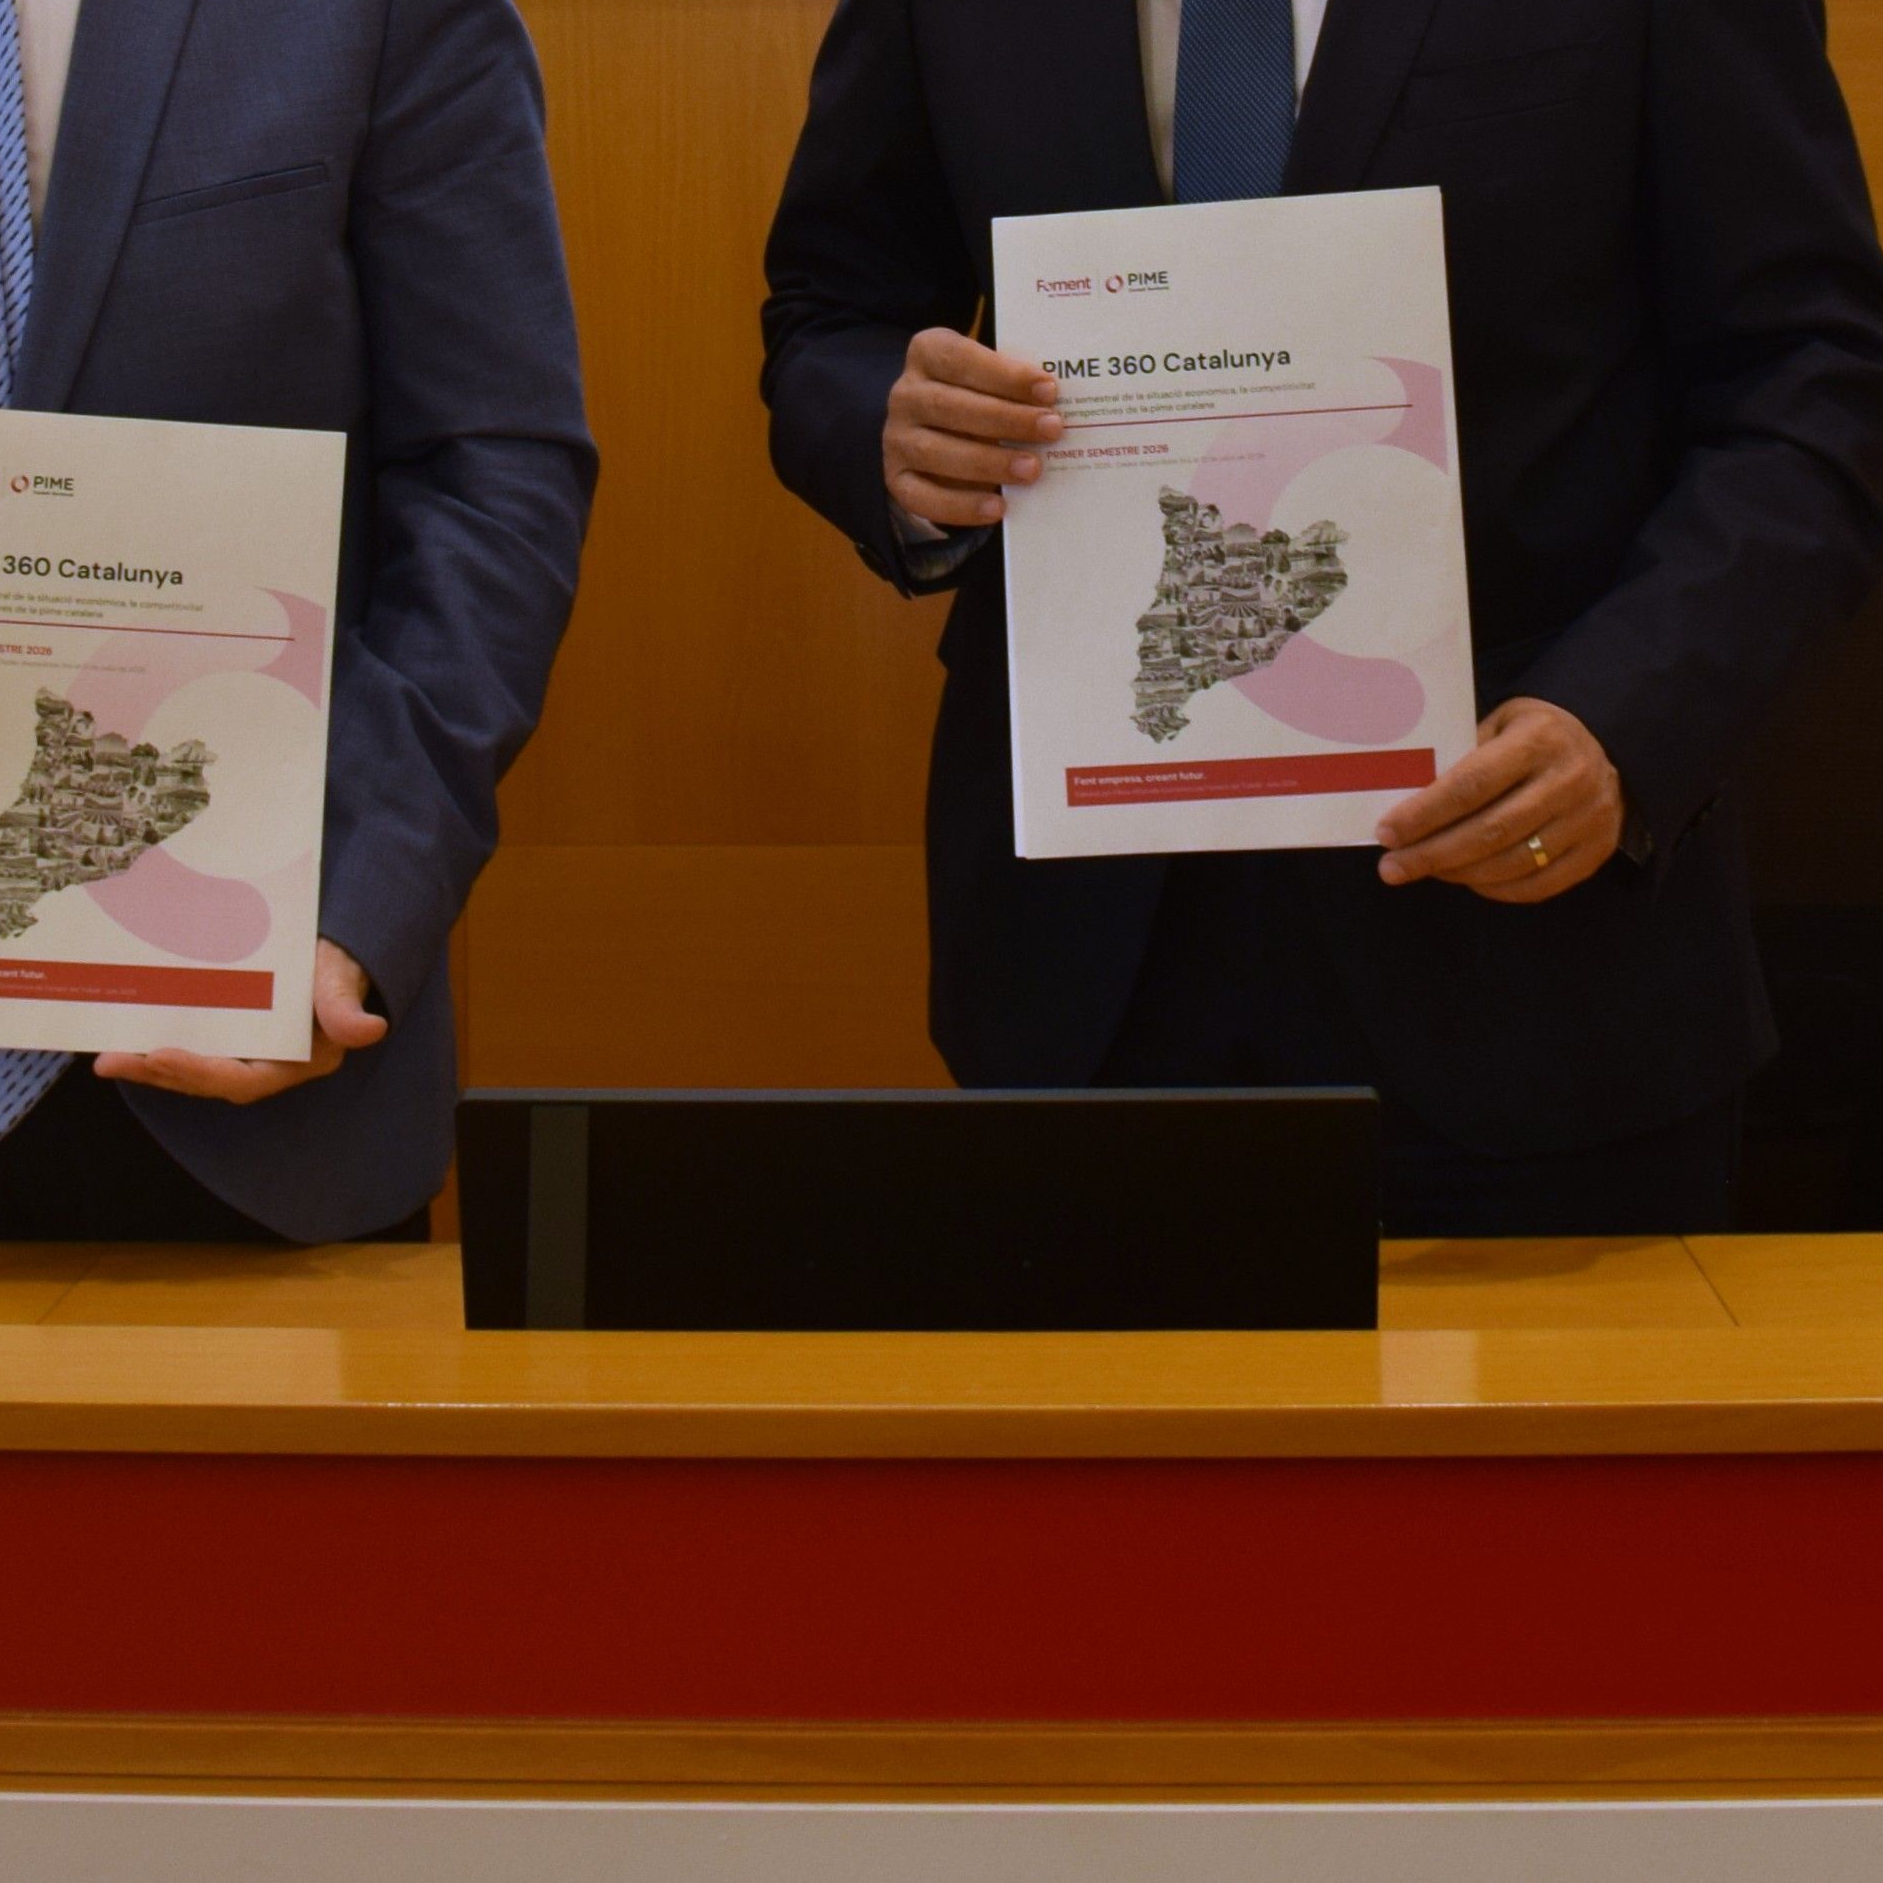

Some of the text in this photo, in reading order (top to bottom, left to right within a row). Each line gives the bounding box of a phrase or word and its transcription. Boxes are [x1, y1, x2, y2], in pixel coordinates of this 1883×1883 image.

[1127, 271, 1168, 286] PIME
[1041, 348, 1291, 380] PIME 360 Catalunya
[1044, 444, 1170, 460] PRIMER SEMESTRE 2026
[33, 476, 74, 491] PIME
[3, 554, 52, 577] 360
[58, 558, 184, 589] Catalunya
[26, 645, 53, 656] 2026
